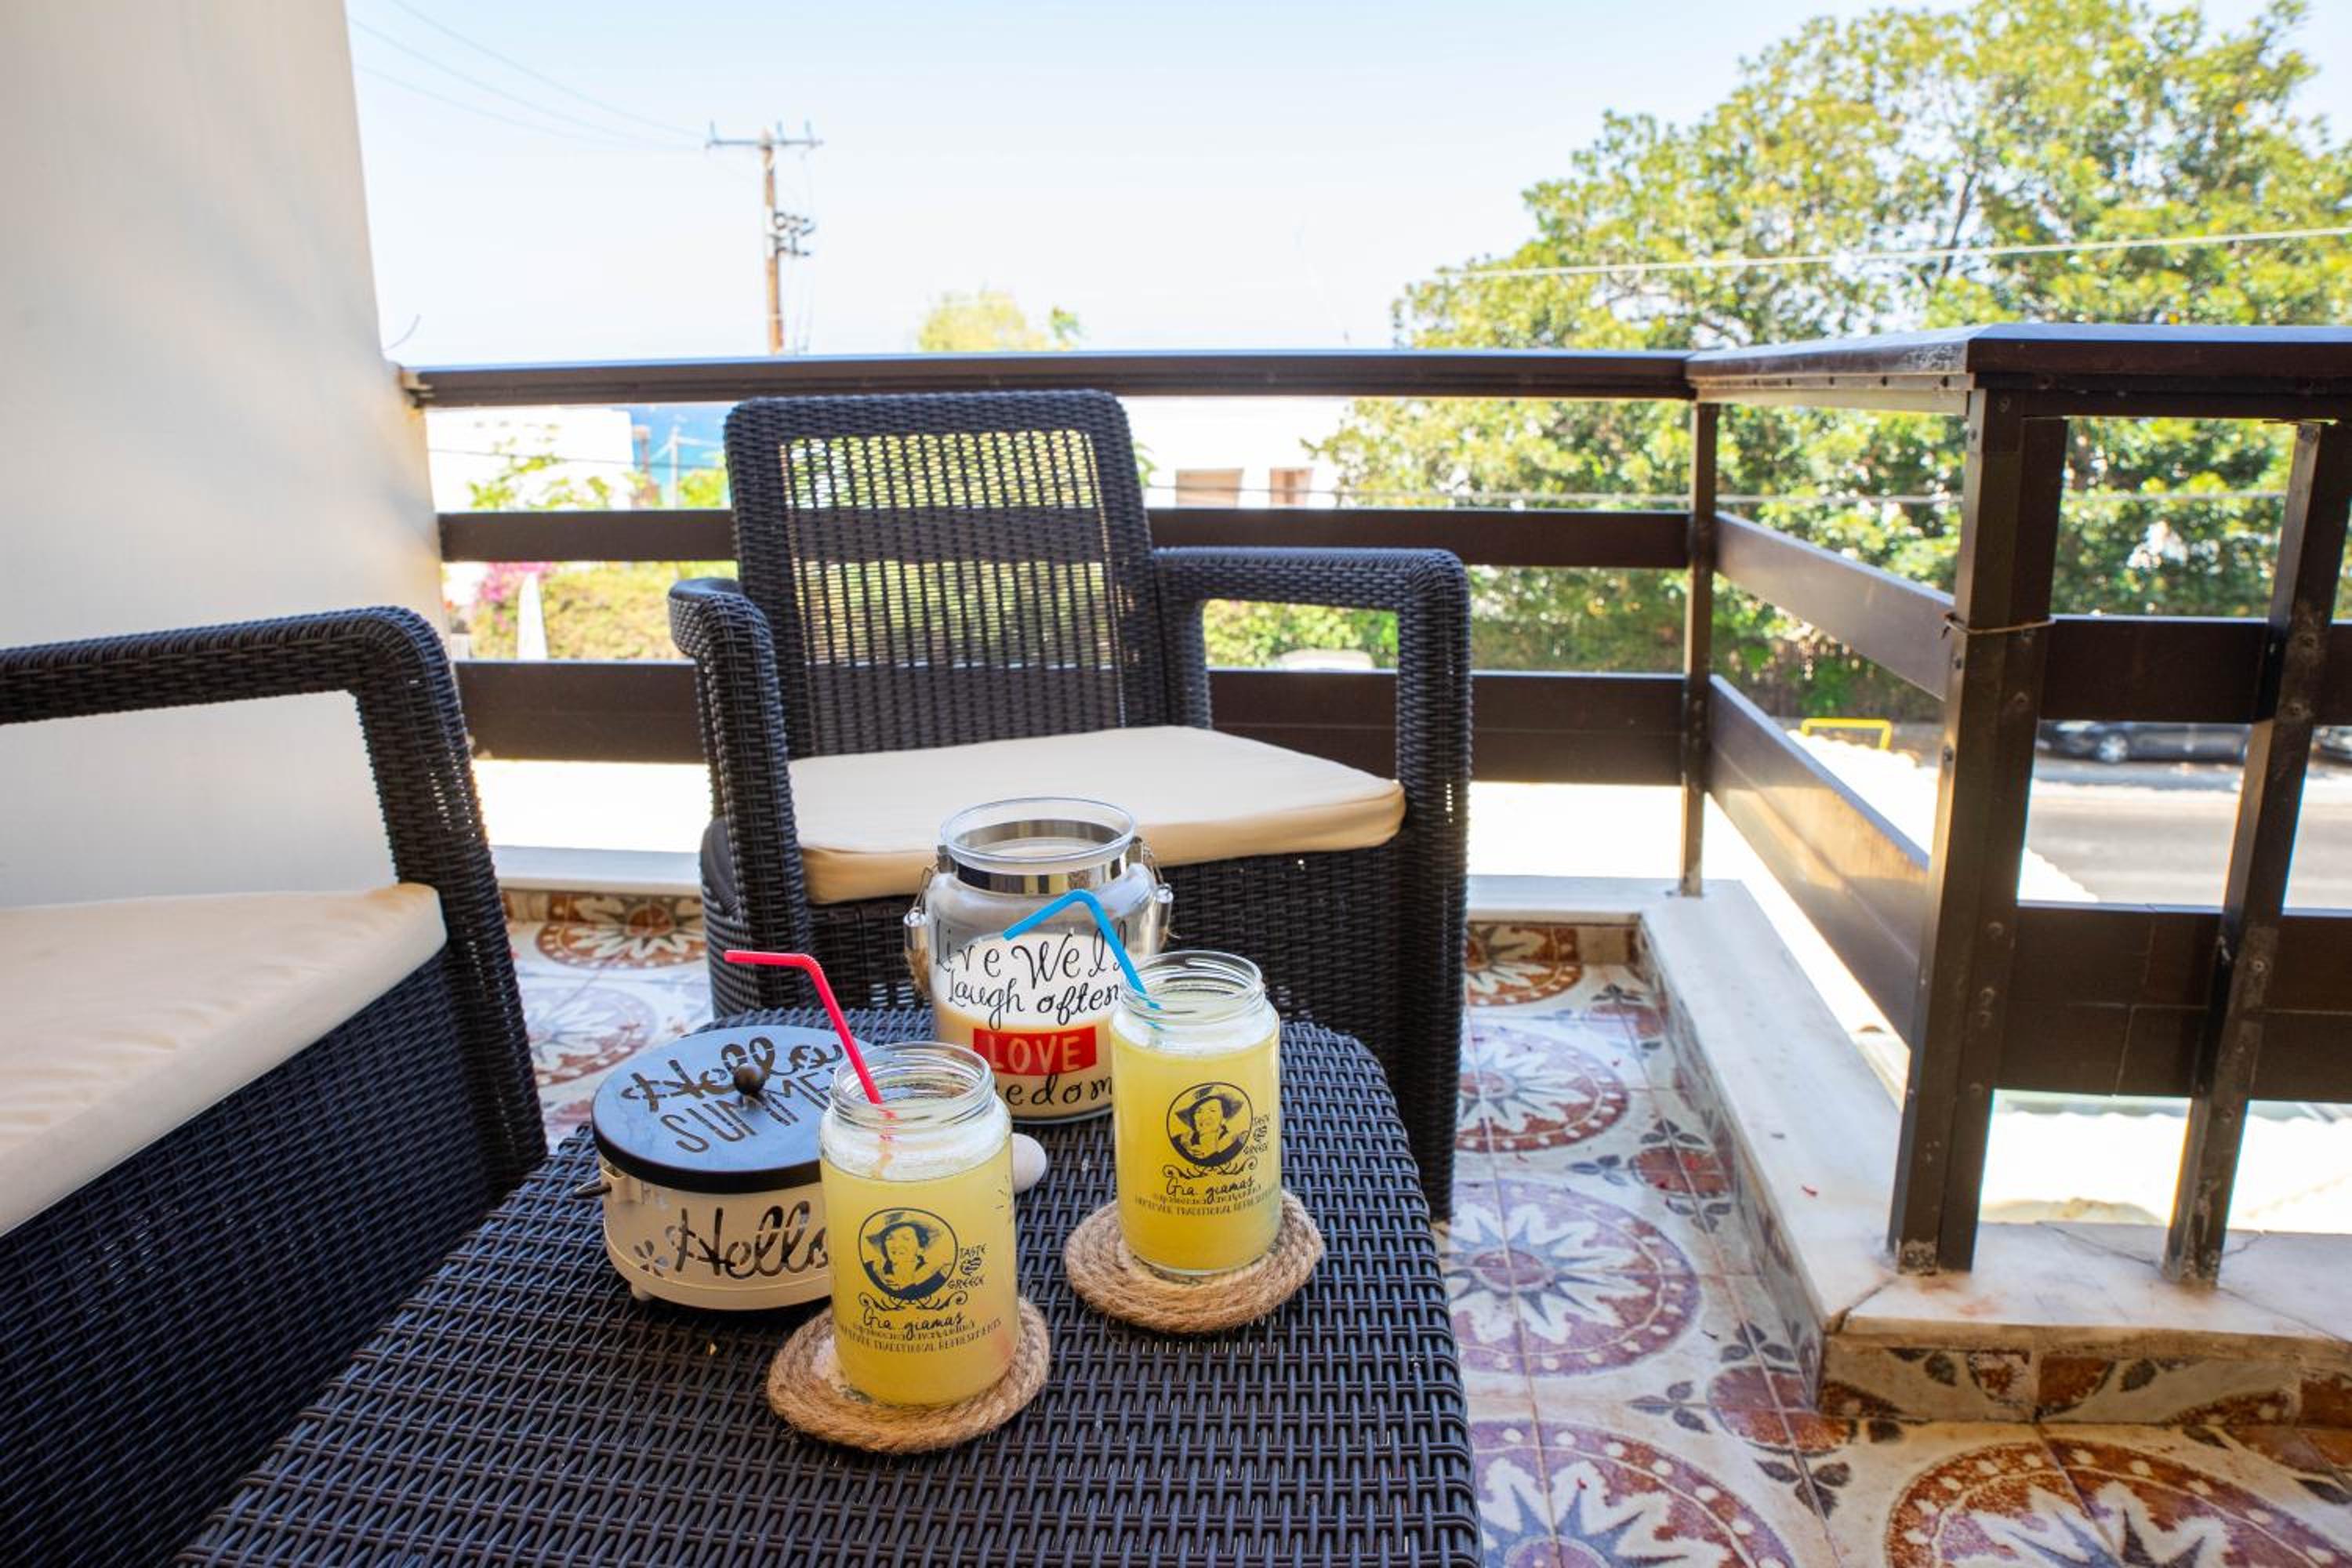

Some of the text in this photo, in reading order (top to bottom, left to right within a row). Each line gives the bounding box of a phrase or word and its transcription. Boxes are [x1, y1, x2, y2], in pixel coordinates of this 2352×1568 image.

[935, 919, 1001, 978] Live
[1036, 982, 1119, 1025] often
[621, 1036, 844, 1113] Hello
[986, 1033, 1082, 1074] LOVE
[659, 1066, 837, 1154] SUMME
